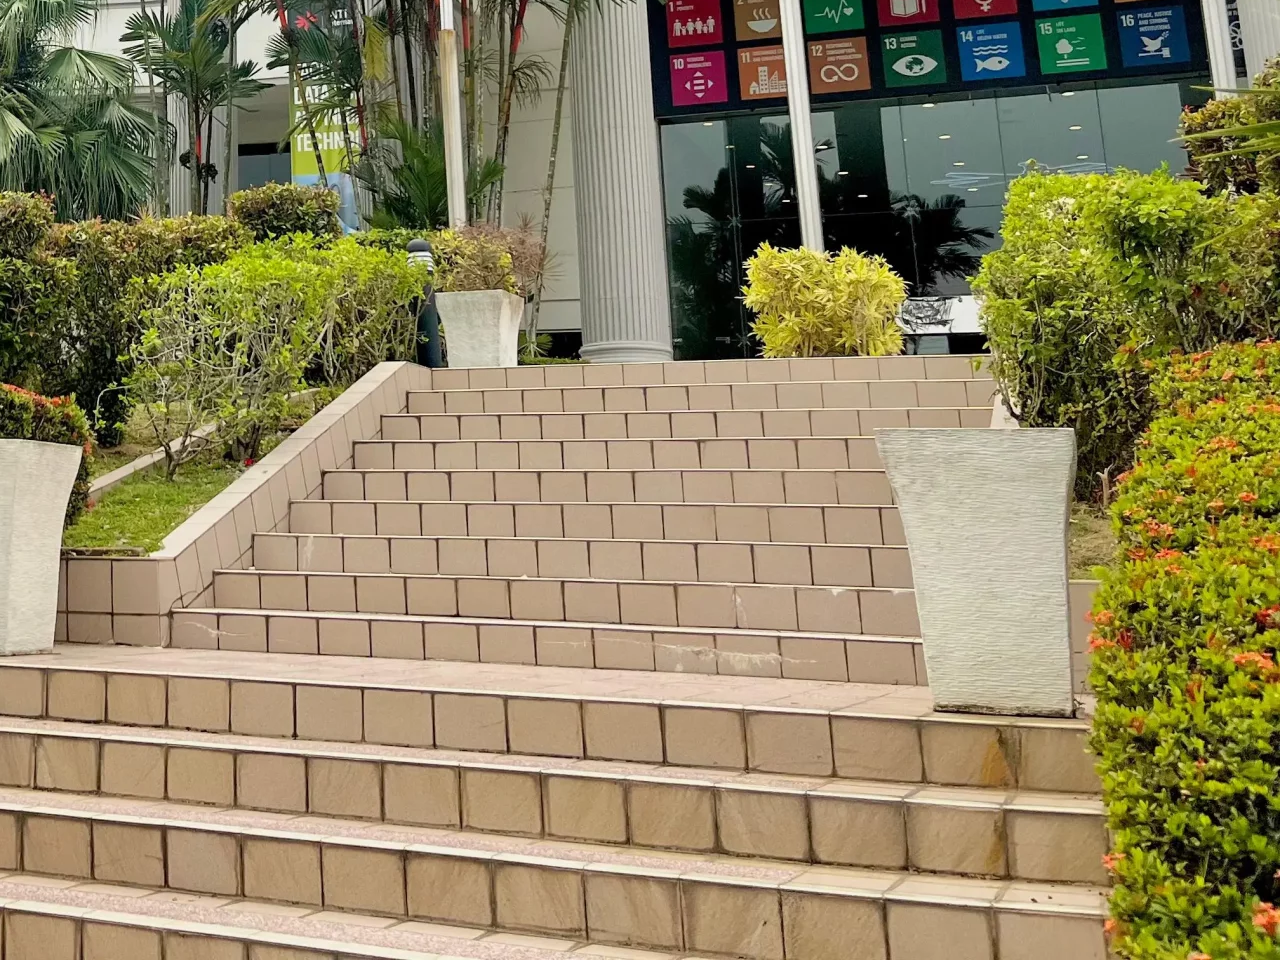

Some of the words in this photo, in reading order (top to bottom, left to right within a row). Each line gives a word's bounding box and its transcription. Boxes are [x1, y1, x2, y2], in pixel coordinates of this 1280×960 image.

[668, 1, 674, 12] 1
[1120, 14, 1134, 27] 16
[1039, 22, 1053, 35] 15
[960, 30, 973, 43] 14
[884, 37, 897, 50] 13
[740, 51, 750, 63] 11
[810, 44, 823, 57] 12
[673, 59, 684, 70] 10
